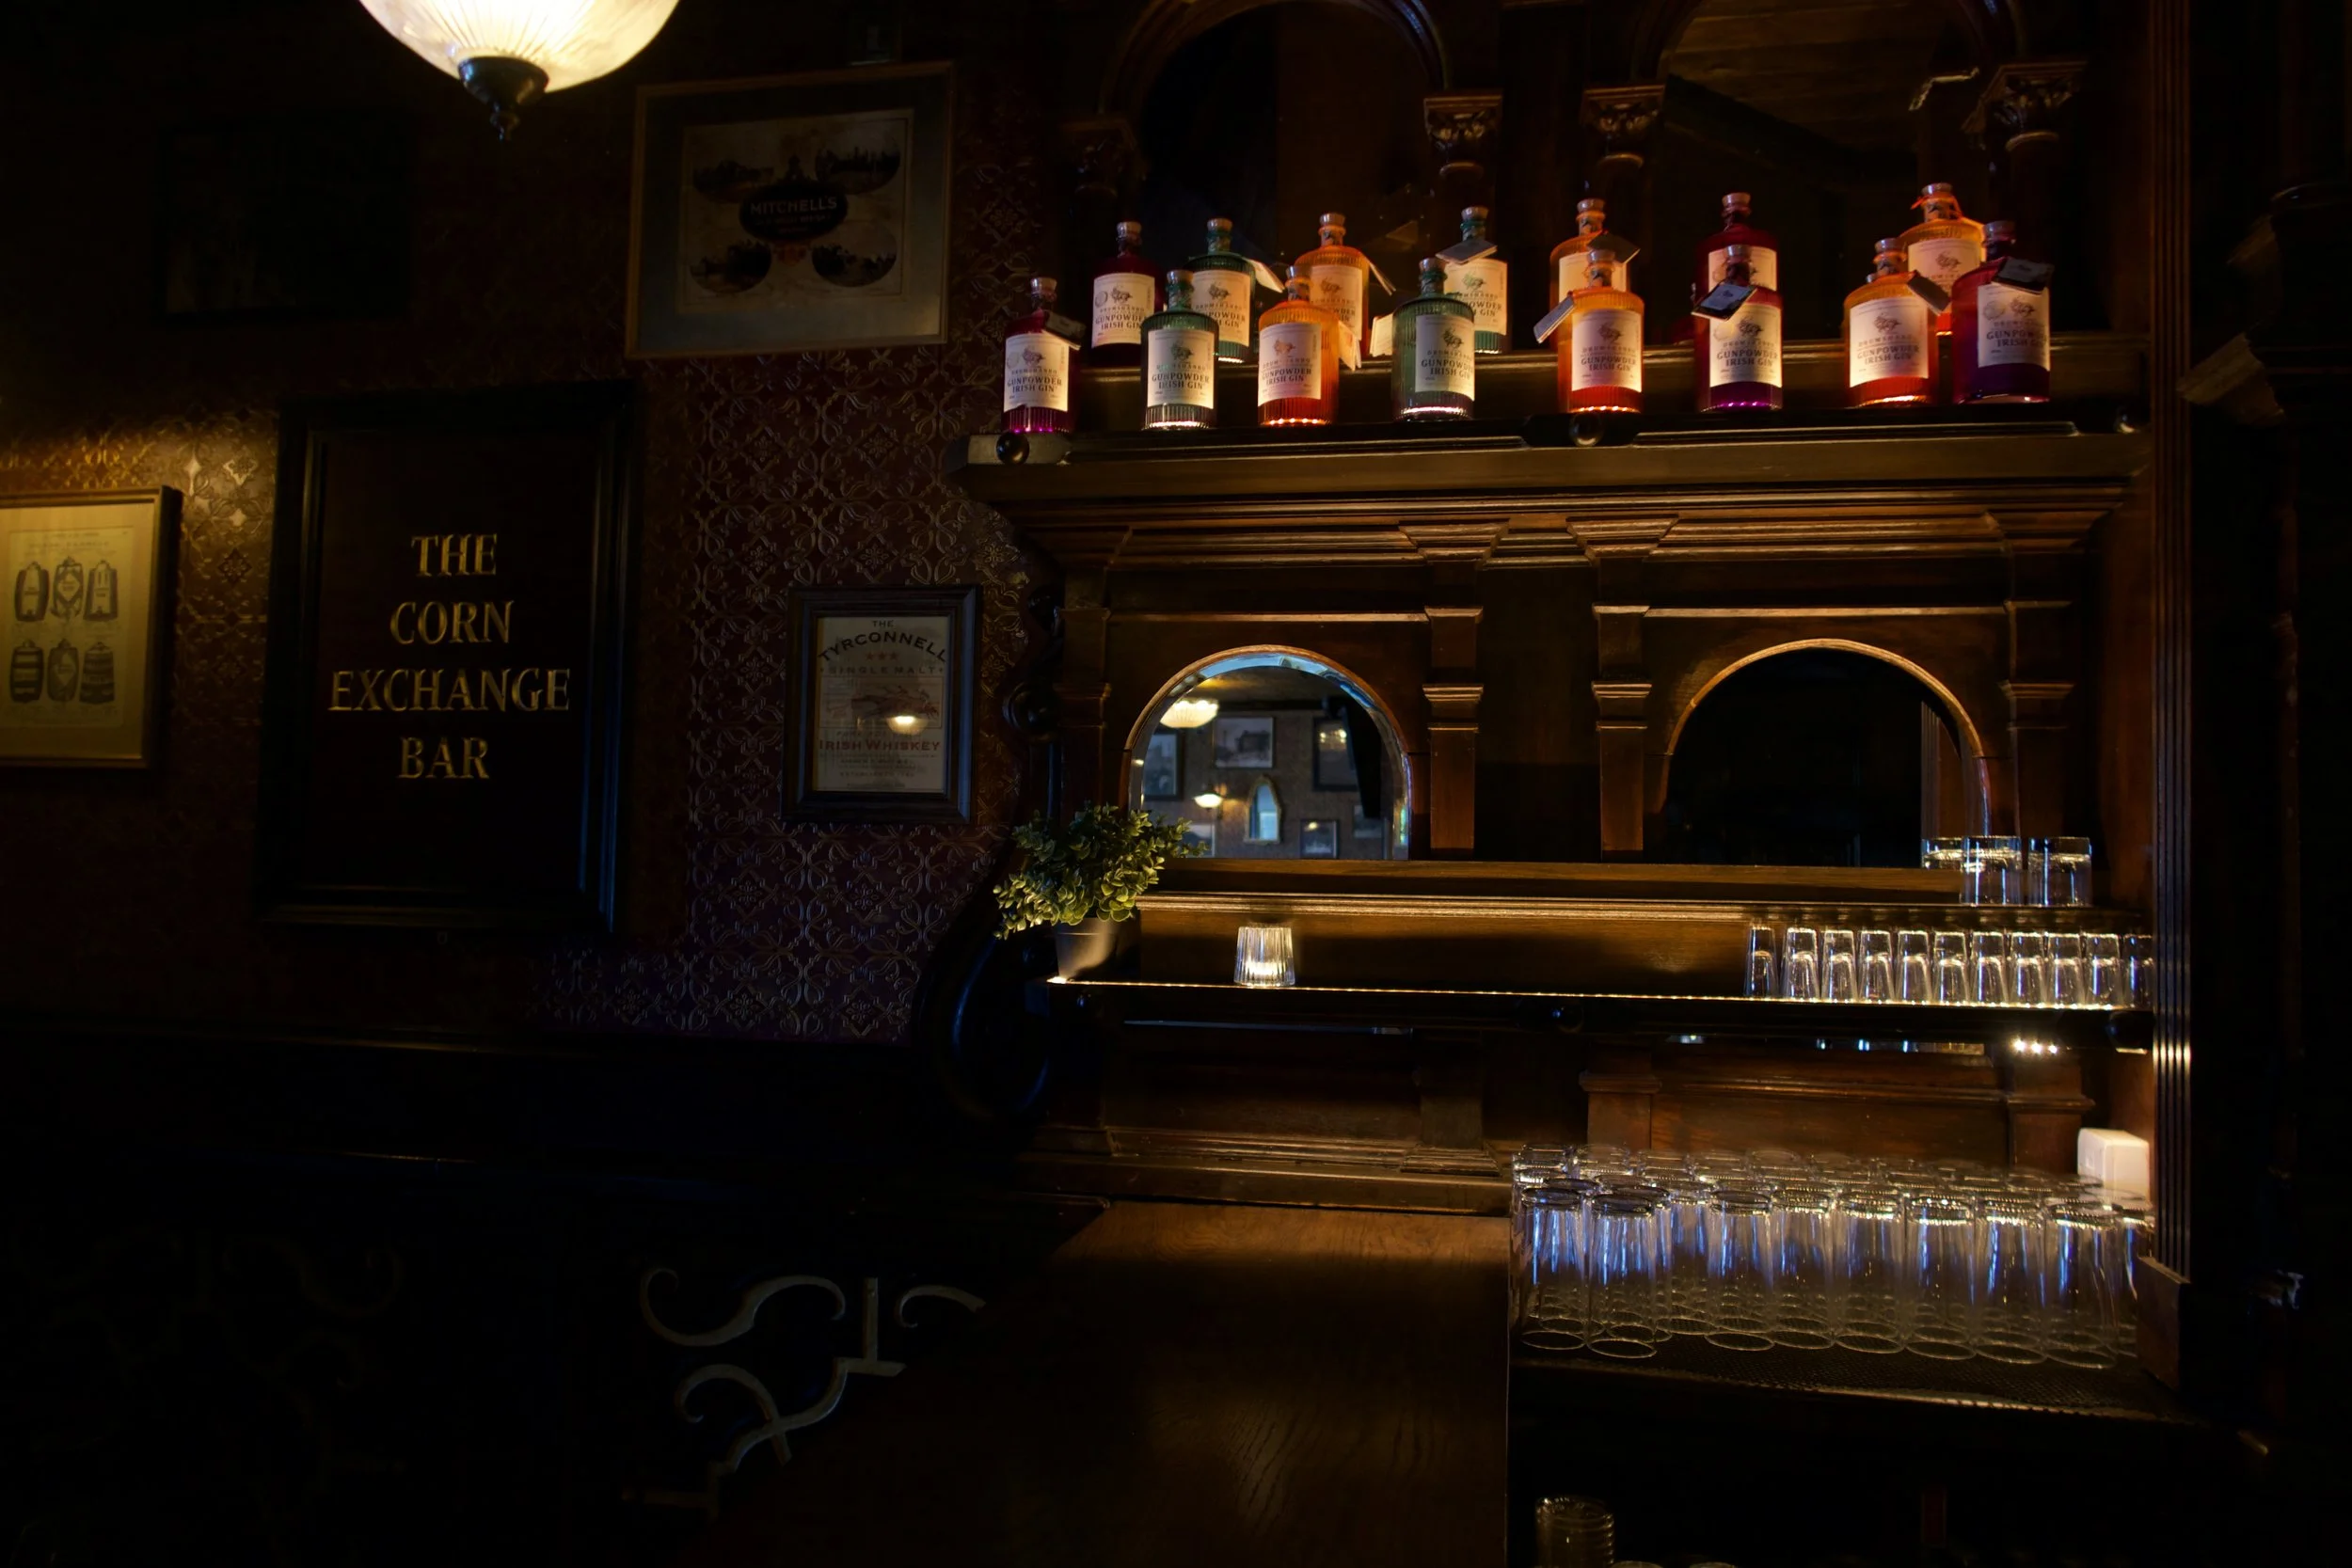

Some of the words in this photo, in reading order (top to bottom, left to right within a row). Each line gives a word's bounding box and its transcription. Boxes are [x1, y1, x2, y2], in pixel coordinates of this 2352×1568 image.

[751, 196, 837, 215] MITCHELL'S
[1101, 322, 1123, 330] IRISH
[1996, 338, 2028, 347] IRISH
[1725, 356, 1755, 366] IRISH
[1756, 356, 1773, 367] GIN
[1865, 354, 1891, 365] IRISH
[1429, 367, 1456, 376] IRISH
[1589, 362, 1615, 371] IRISH
[1616, 363, 1630, 372] GIN
[1152, 372, 1210, 382] GUNPOWDER
[1262, 368, 1311, 379] GUNPOWDER
[1007, 375, 1062, 387] GUNPOWDER
[1158, 381, 1184, 389] IRISH
[1186, 381, 1202, 389] GIN
[1266, 375, 1288, 385] IRISH
[1288, 374, 1304, 383] GIN
[1012, 384, 1036, 393] IRISH
[1038, 384, 1055, 392] GIN
[411, 532, 498, 578] THE
[389, 599, 516, 645] CORN
[817, 631, 946, 662] TYRCONNELL
[894, 666, 934, 674] MALT
[327, 668, 571, 713] EXCHANGE
[819, 739, 861, 751] IRISH
[866, 739, 941, 751] WHISKEY
[396, 736, 490, 780] BAR
